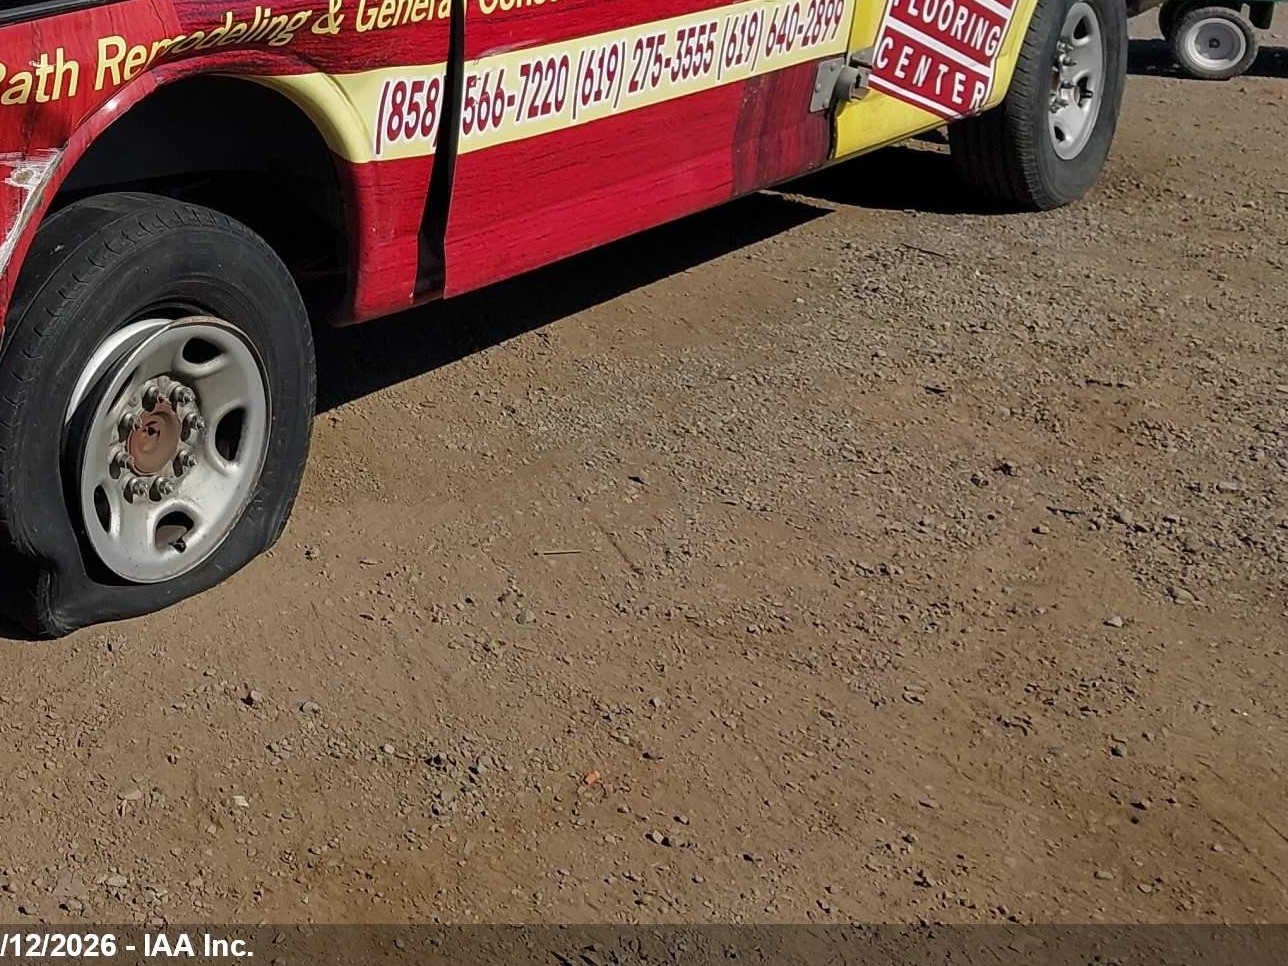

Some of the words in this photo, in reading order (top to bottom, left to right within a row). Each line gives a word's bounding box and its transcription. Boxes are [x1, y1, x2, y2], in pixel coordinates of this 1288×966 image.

[463, 54, 570, 135] 566-7220
[573, 42, 626, 119] (619)
[628, 23, 717, 94] 275-3555
[716, 9, 765, 81] (619)
[876, 36, 988, 110] CENTER
